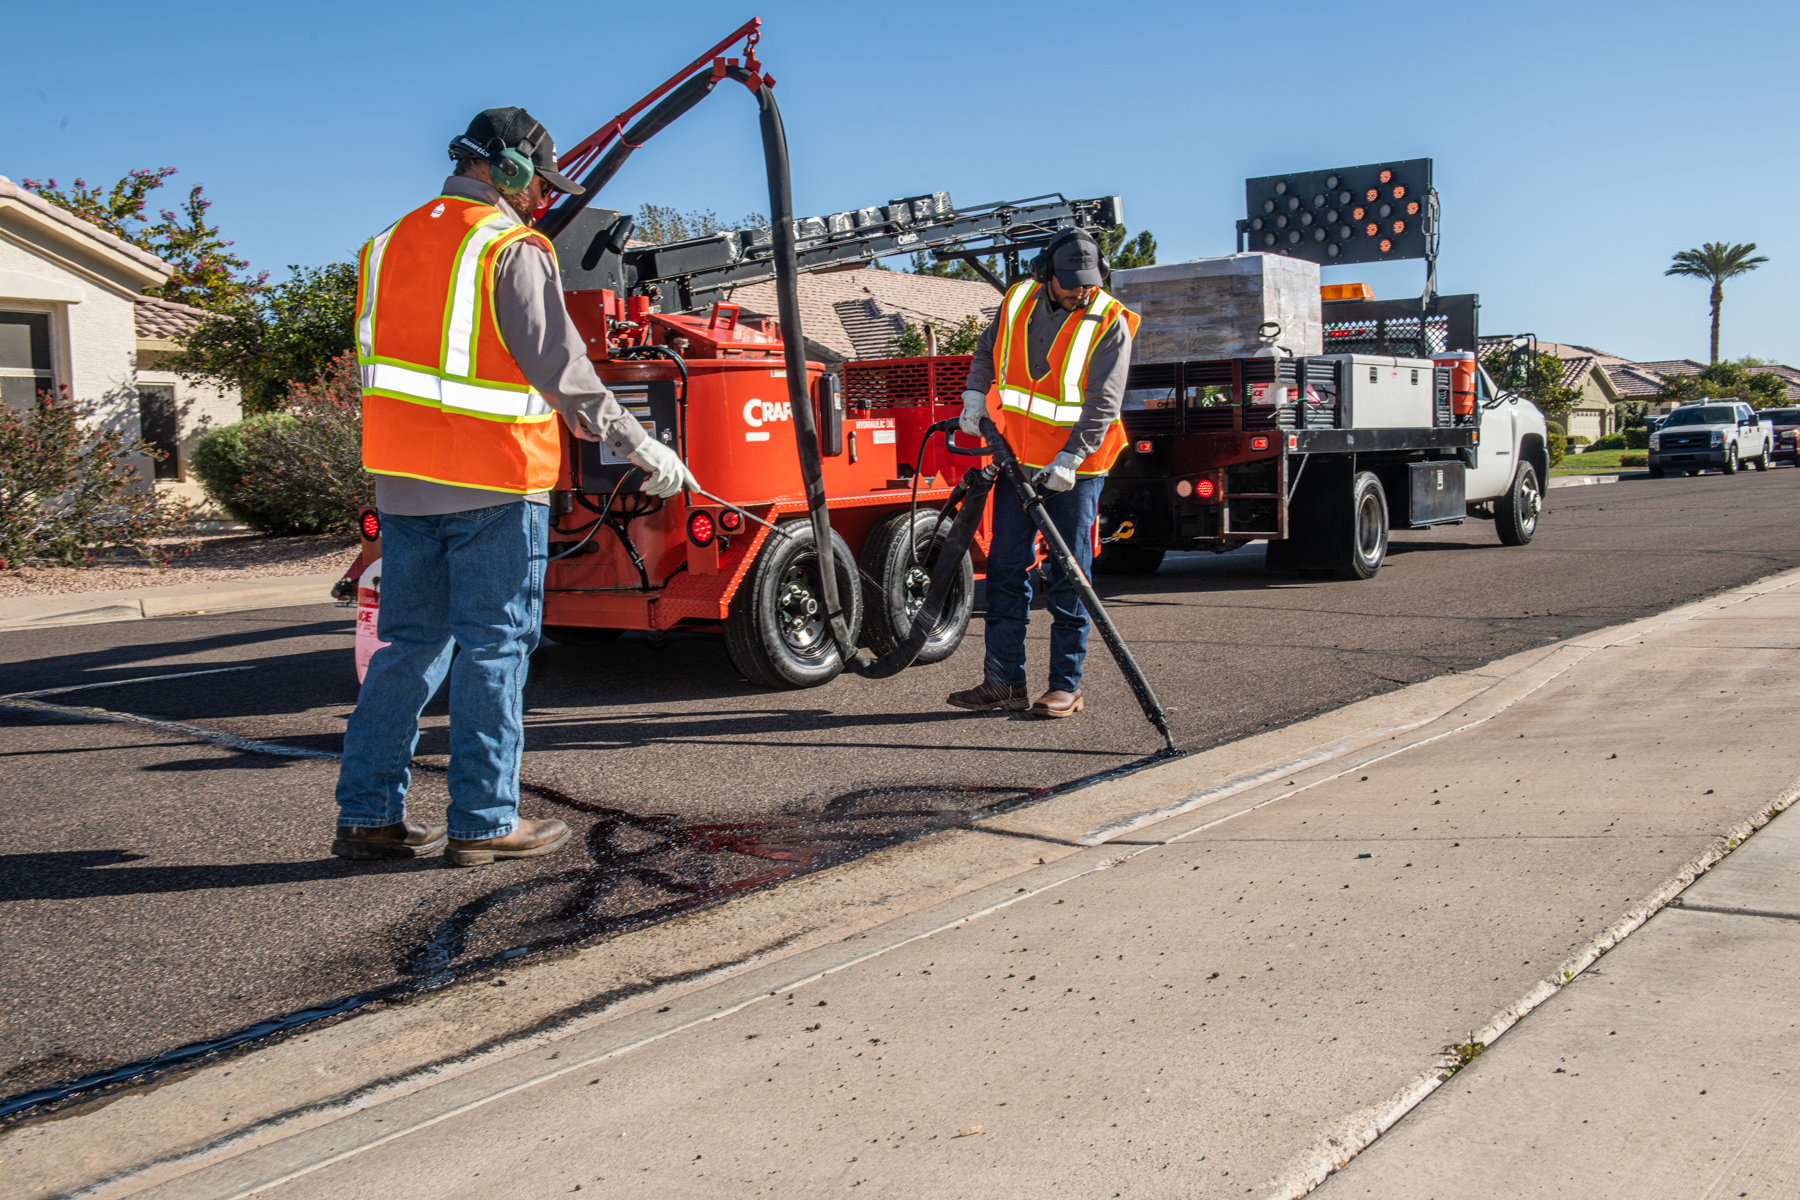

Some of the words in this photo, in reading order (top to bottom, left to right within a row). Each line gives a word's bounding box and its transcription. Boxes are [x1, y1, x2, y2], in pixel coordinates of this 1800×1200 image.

[743, 398, 793, 427] CRAF
[855, 420, 885, 429] HYDRAULIC
[886, 420, 896, 428] OIL
